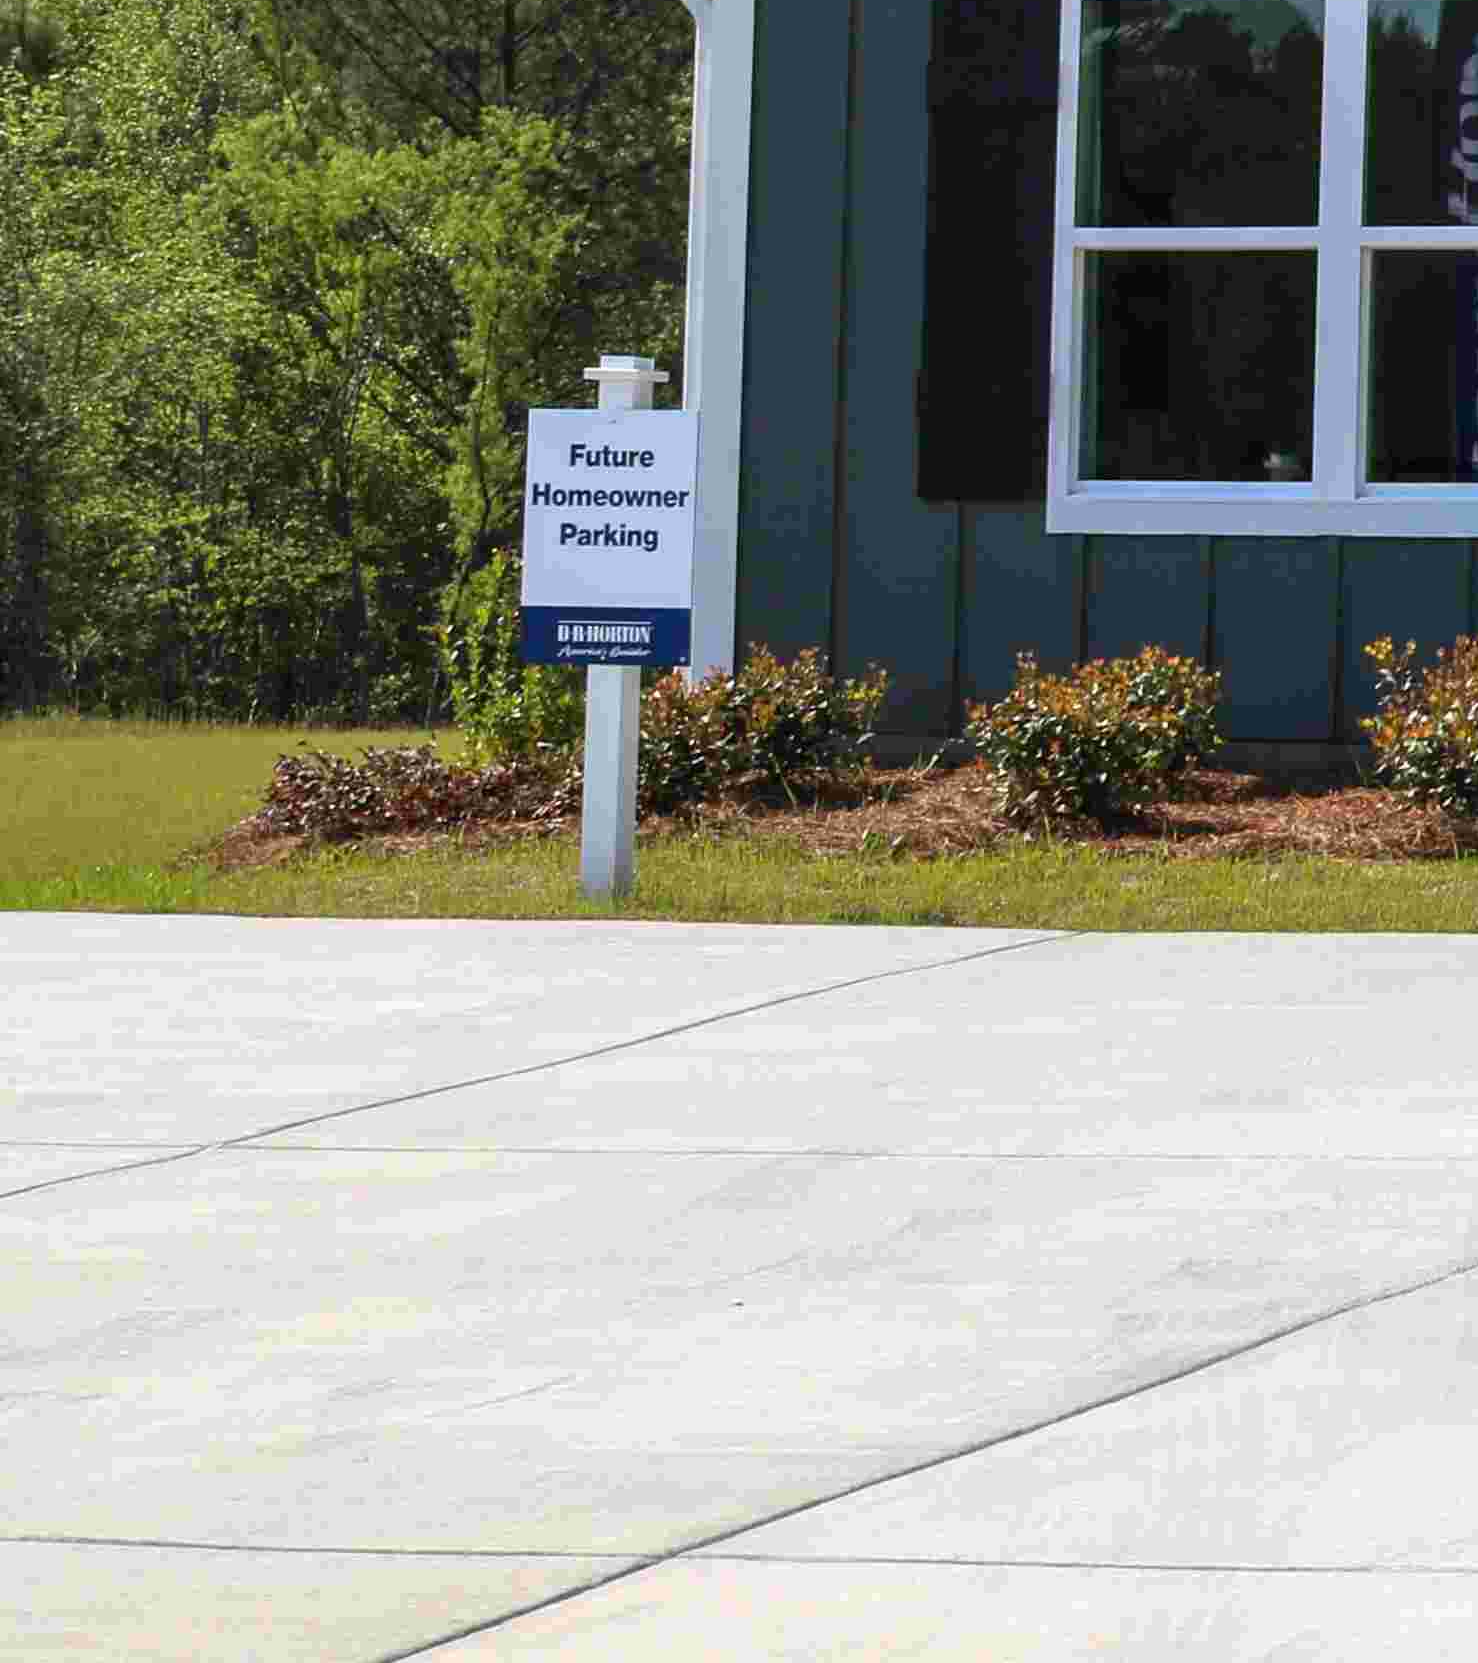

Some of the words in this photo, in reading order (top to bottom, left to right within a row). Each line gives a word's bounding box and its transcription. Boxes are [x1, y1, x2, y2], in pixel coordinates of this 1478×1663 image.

[570, 444, 654, 467] Future
[532, 483, 689, 507] Homeowner
[560, 523, 658, 552] Parking
